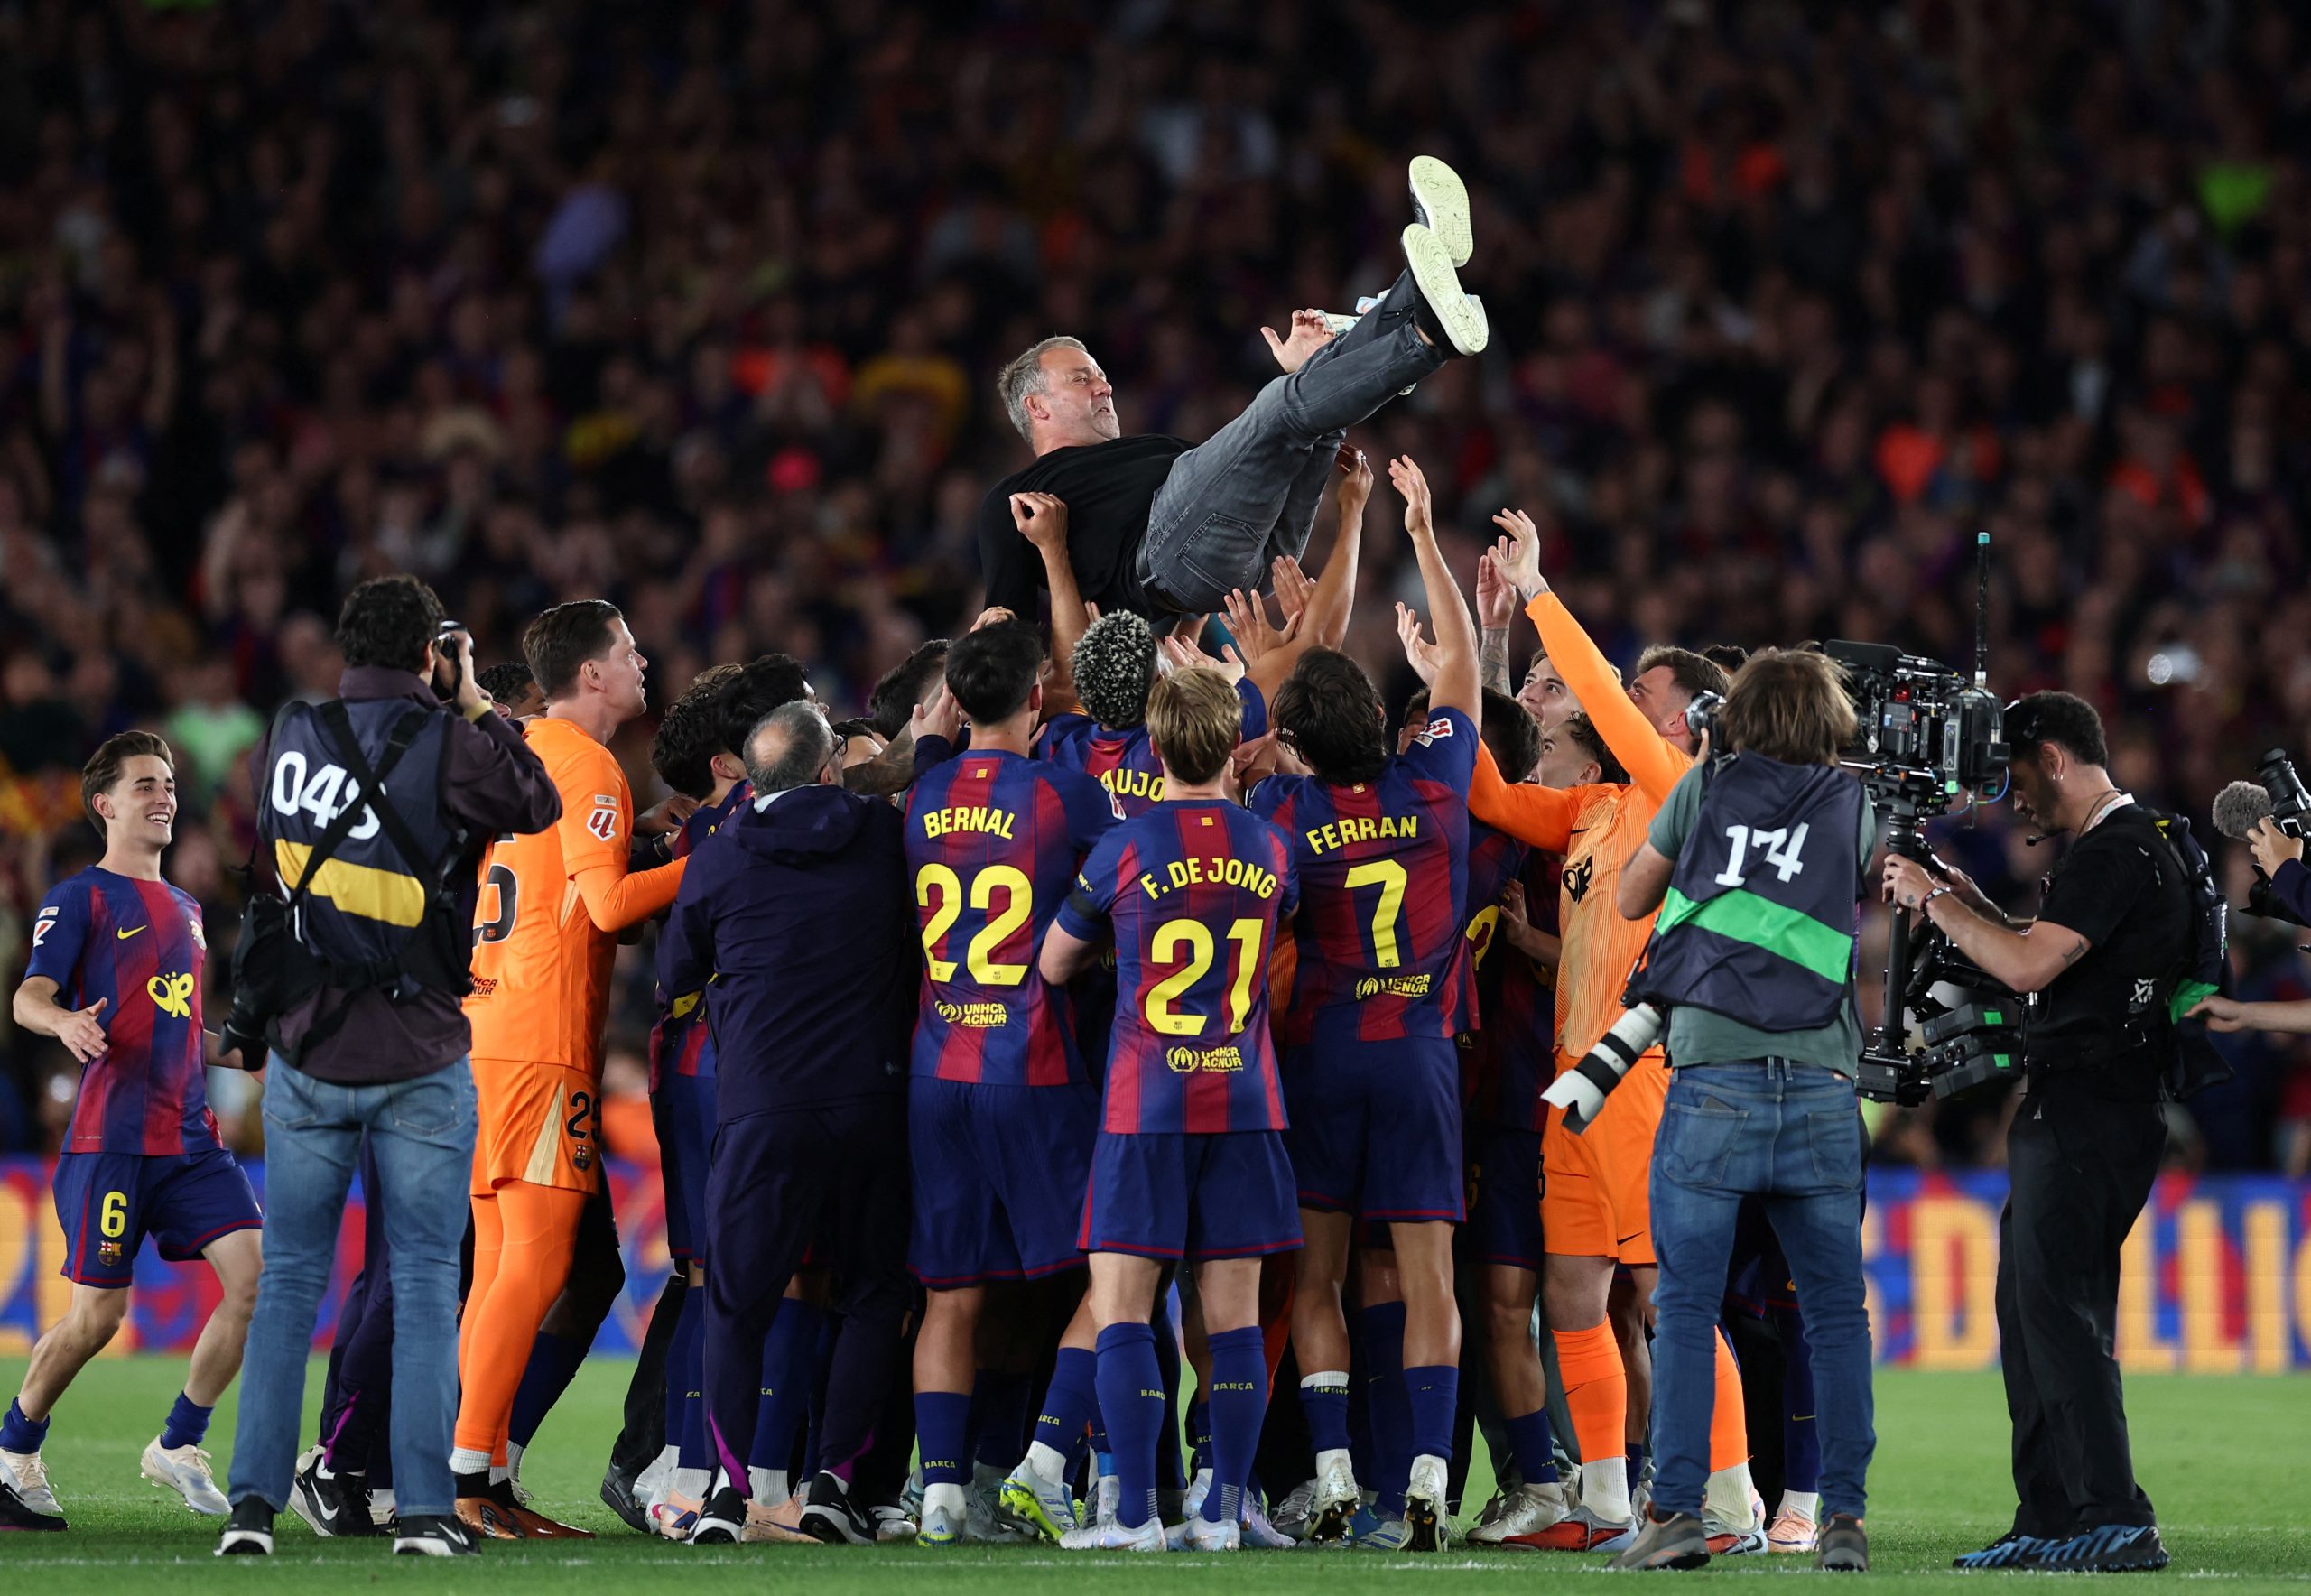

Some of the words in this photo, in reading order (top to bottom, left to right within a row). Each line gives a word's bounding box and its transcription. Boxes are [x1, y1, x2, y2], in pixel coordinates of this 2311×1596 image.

[1100, 768, 1165, 802] AUJO
[923, 806, 1015, 840] BERNAL
[1306, 816, 1417, 855] FERRAN
[1715, 822, 1809, 887] 174
[1140, 873, 1170, 901] F.
[1167, 858, 1204, 889] DE
[1207, 858, 1277, 899] JONG
[916, 863, 1033, 986] 22
[1344, 858, 1407, 968] 7
[470, 976, 498, 988] HCR
[1146, 918, 1264, 1036] 21
[961, 1014, 1007, 1025] ACNUR
[963, 1003, 1007, 1015] UNHCR
[1201, 1047, 1239, 1060] UNHCR
[1202, 1057, 1243, 1068] ACNUR
[100, 1191, 128, 1238] 6
